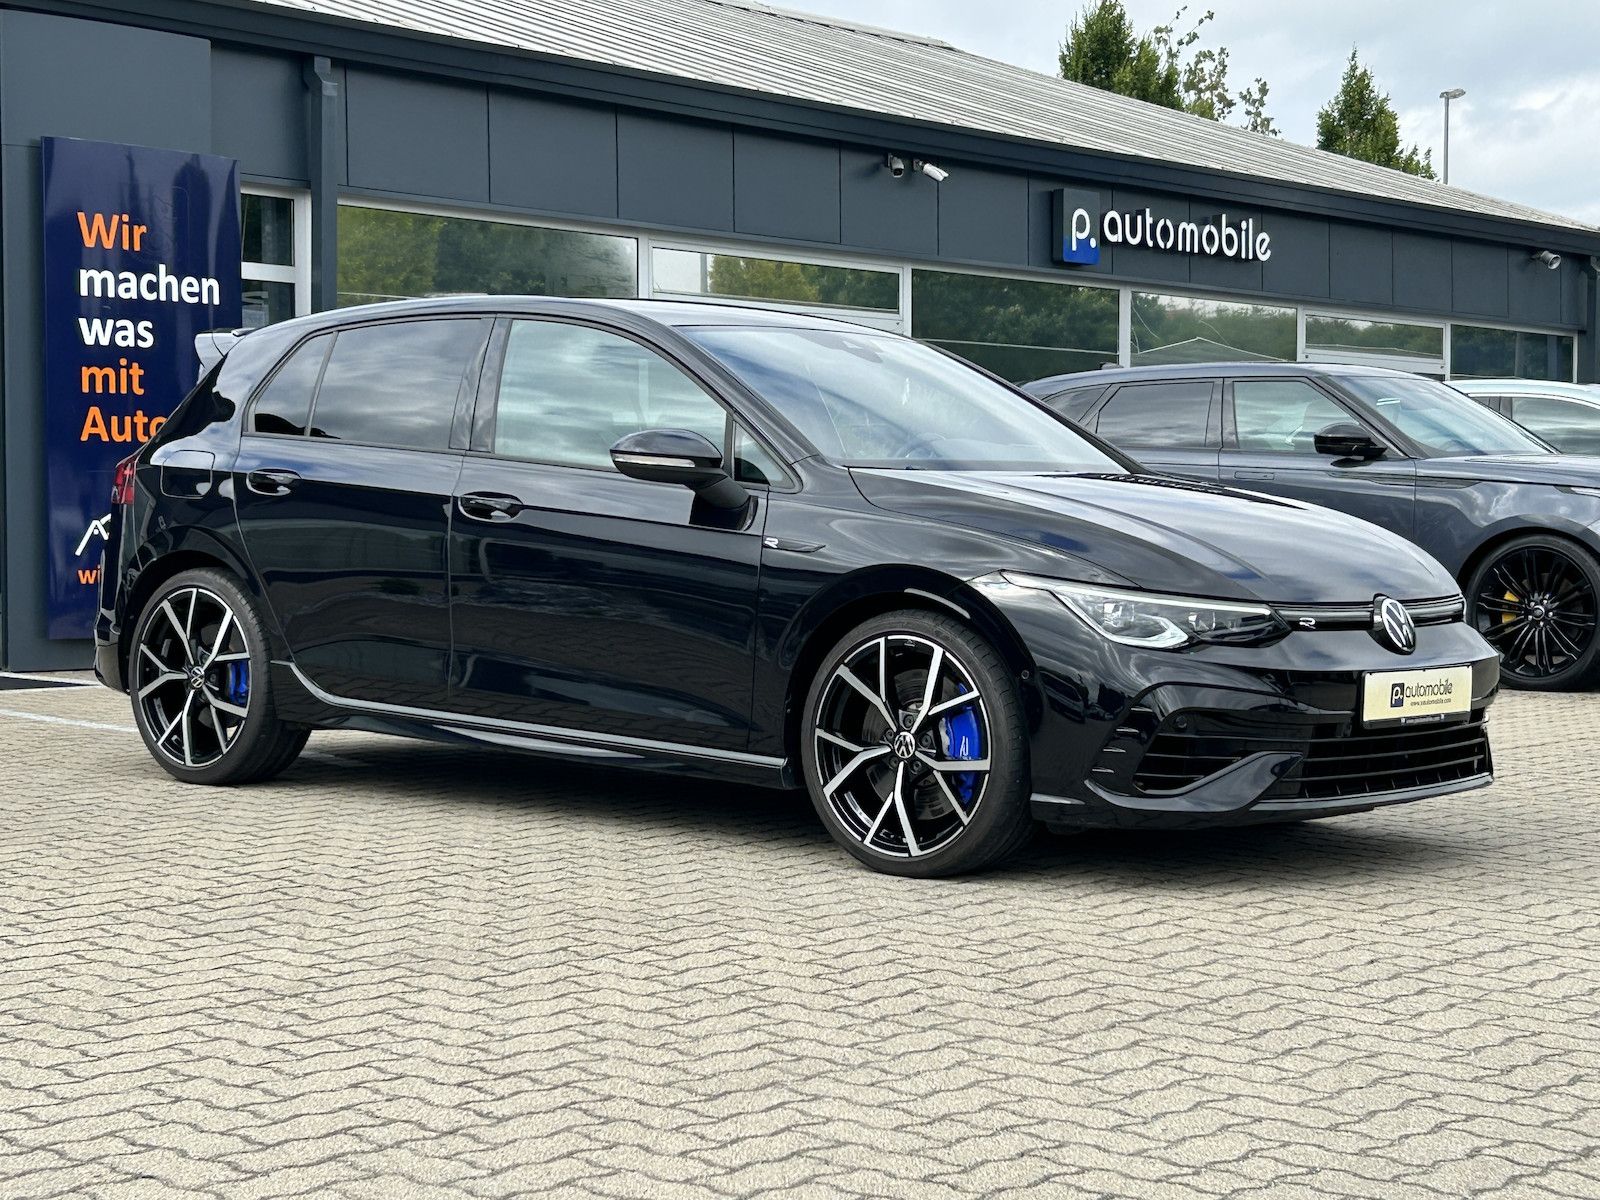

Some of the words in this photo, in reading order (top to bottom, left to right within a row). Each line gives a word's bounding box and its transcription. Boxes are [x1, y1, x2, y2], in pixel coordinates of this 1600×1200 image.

[77, 211, 147, 251] Wir
[1103, 207, 1272, 262] automobile
[79, 263, 220, 305] machen
[78, 317, 154, 348] was
[81, 357, 145, 395] mit
[1405, 678, 1453, 698] automobile
